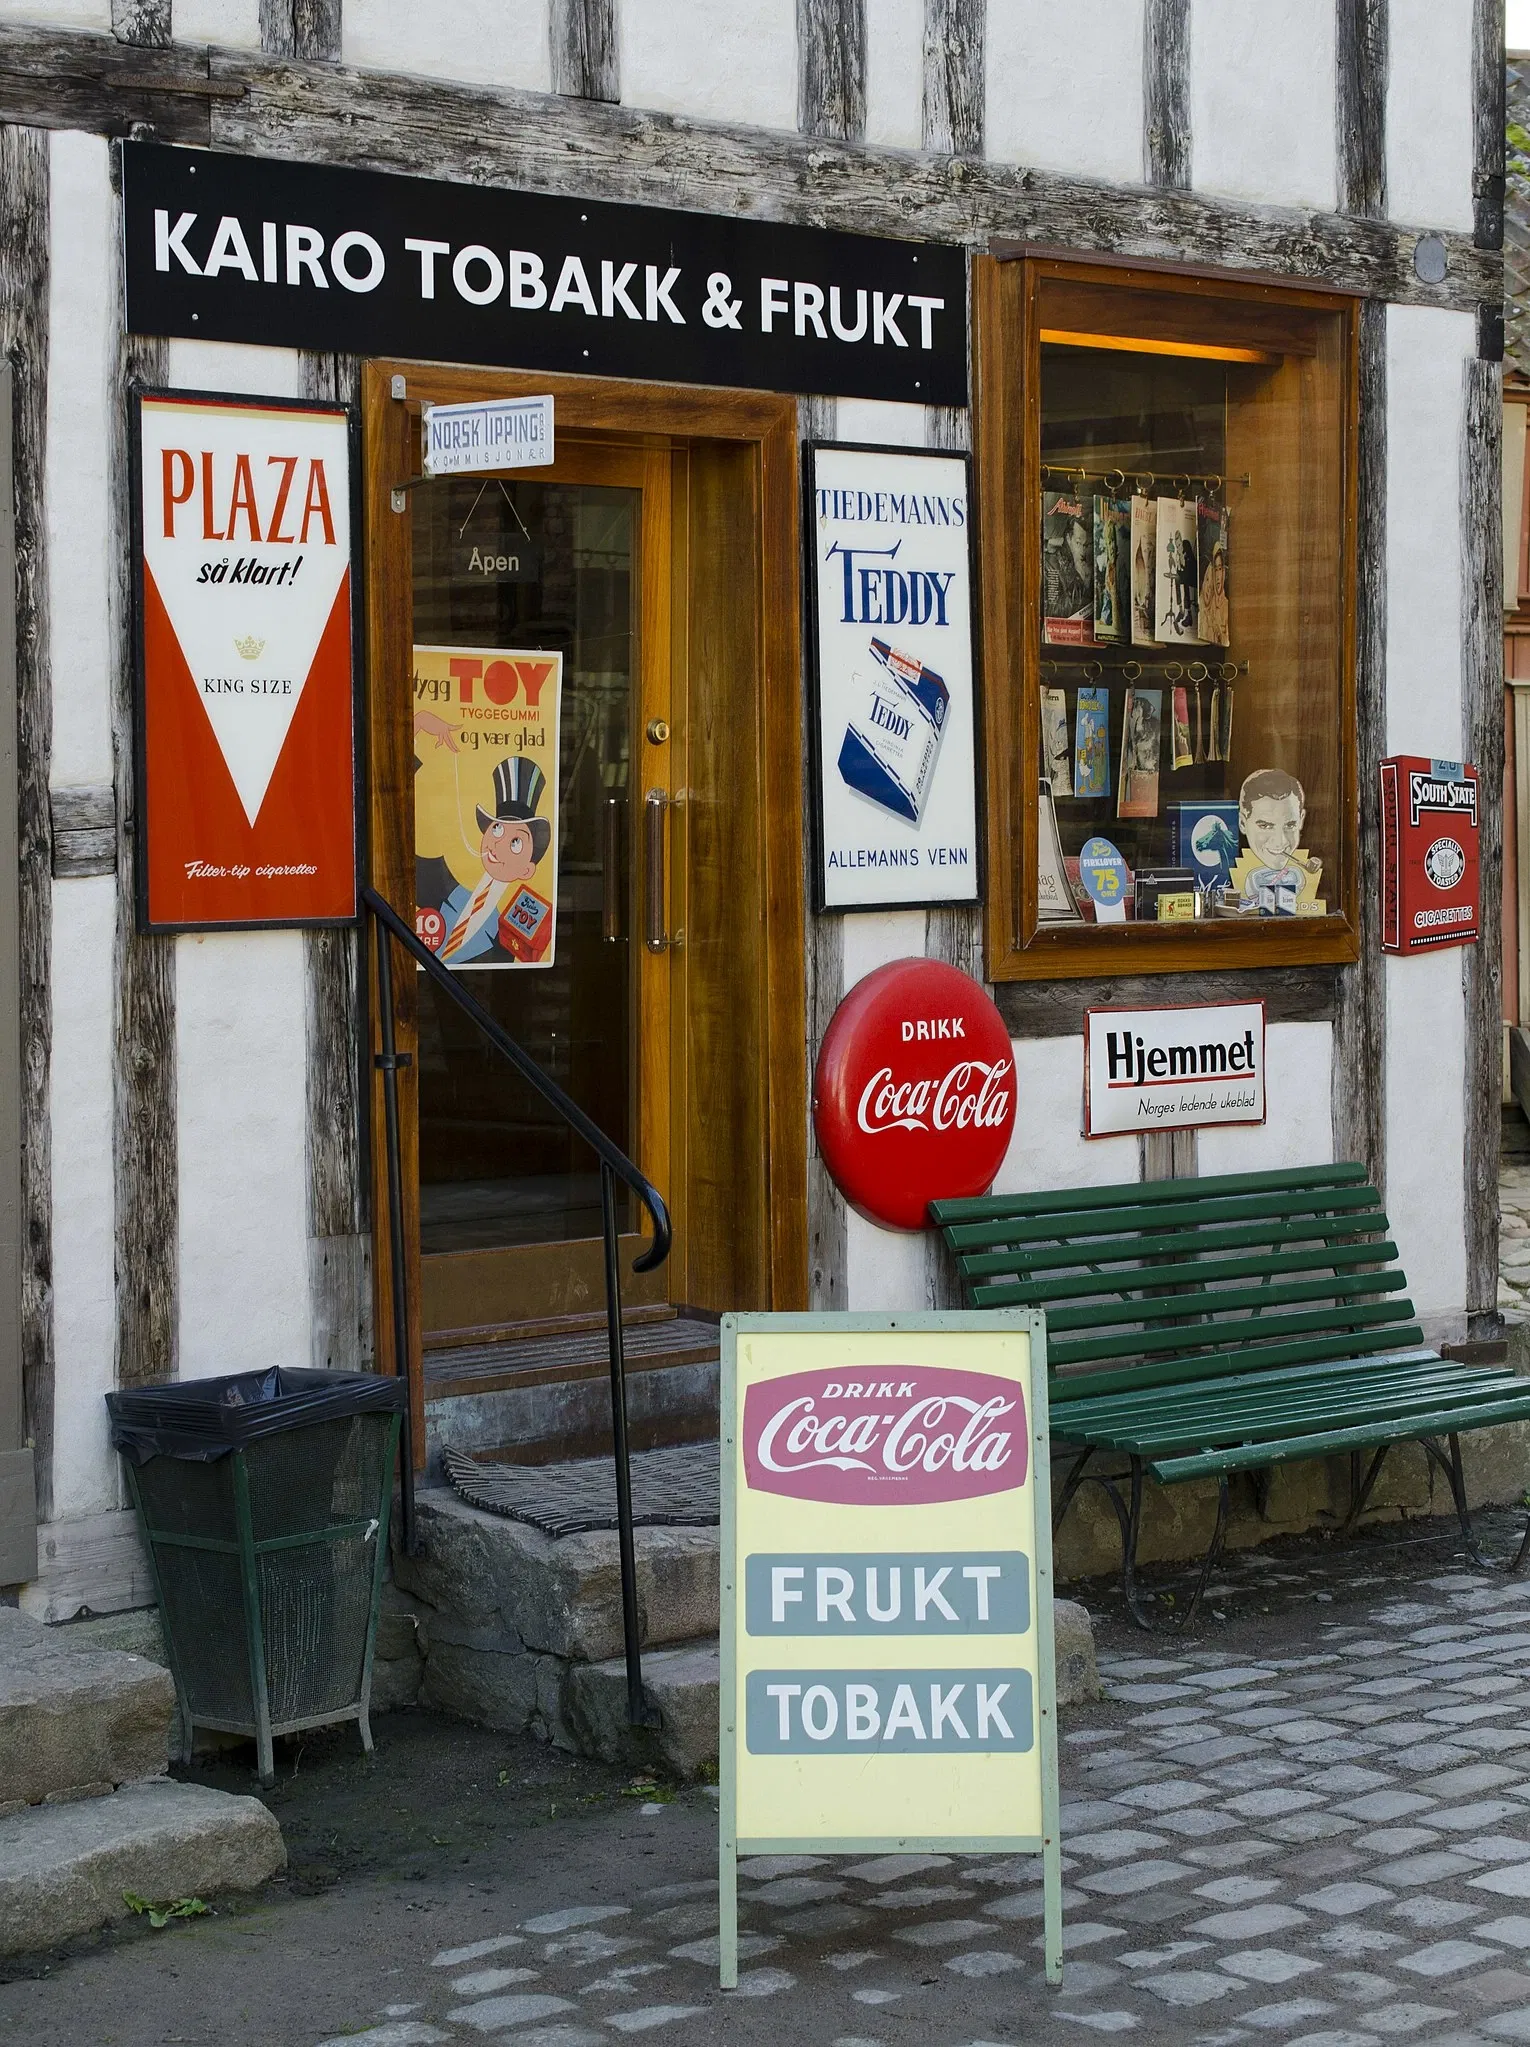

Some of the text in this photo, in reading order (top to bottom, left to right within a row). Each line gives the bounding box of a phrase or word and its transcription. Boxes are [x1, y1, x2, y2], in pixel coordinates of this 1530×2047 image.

[154, 208, 945, 350] KAIRO TOBAKK & FRUKT
[432, 418, 481, 451] NORSK
[485, 410, 538, 446] TIPPING
[432, 447, 546, 469] KOMMISJONÆR
[161, 448, 338, 546] PLAZA
[816, 488, 965, 527] TIEDEMANNS
[196, 555, 304, 586] så klart!
[468, 546, 520, 576] Åpen
[825, 538, 956, 626] TEDDY
[204, 678, 292, 695] KING SIZE
[450, 657, 554, 707] TOY
[460, 707, 540, 722] TYGGEGUMMI
[868, 690, 915, 741] TEDDY
[460, 727, 545, 752] og vær glad
[1413, 776, 1475, 808] SOUTH STATE
[828, 847, 968, 868] ALLEMANNS VENN
[1430, 838, 1462, 856] SPECIALLY
[184, 860, 318, 880] Filter-tip cigarettes
[1092, 868, 1120, 891] 75
[1432, 872, 1459, 887] TOASTED
[416, 914, 441, 935] 10
[511, 904, 538, 930] TOY
[1414, 905, 1473, 929] CIGARETTES
[420, 936, 440, 946] RE
[901, 1017, 966, 1042] DRIKK
[1106, 1030, 1256, 1087] Hjemmet
[857, 1058, 1013, 1134] Coca-Cola
[1137, 1089, 1256, 1118] Norges ledende ukeblad
[821, 1382, 918, 1399] DRIKK
[757, 1395, 1017, 1473] Coca-Cola
[771, 1565, 1001, 1623] FRUKT
[766, 1683, 1015, 1741] TOBAKK
